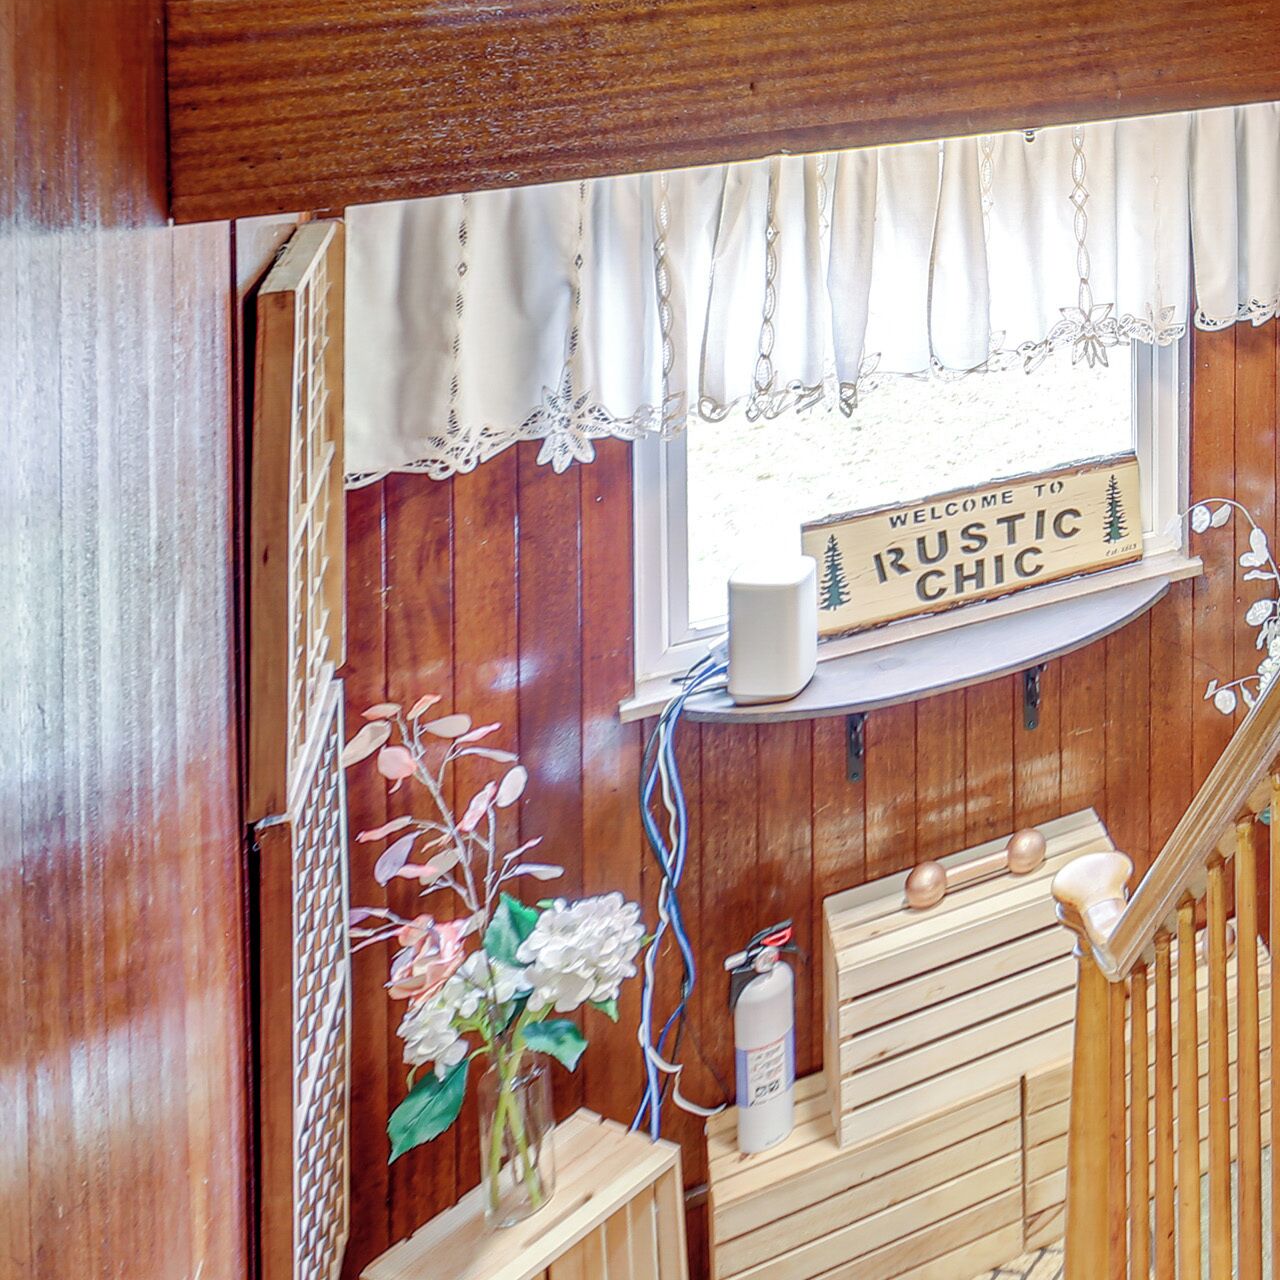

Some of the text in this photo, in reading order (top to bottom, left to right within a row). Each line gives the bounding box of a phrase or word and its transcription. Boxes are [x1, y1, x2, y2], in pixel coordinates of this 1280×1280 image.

[890, 480, 1065, 528] WELCOME TO
[873, 508, 1082, 584] RUSTIC
[916, 546, 1044, 601] CHIC
